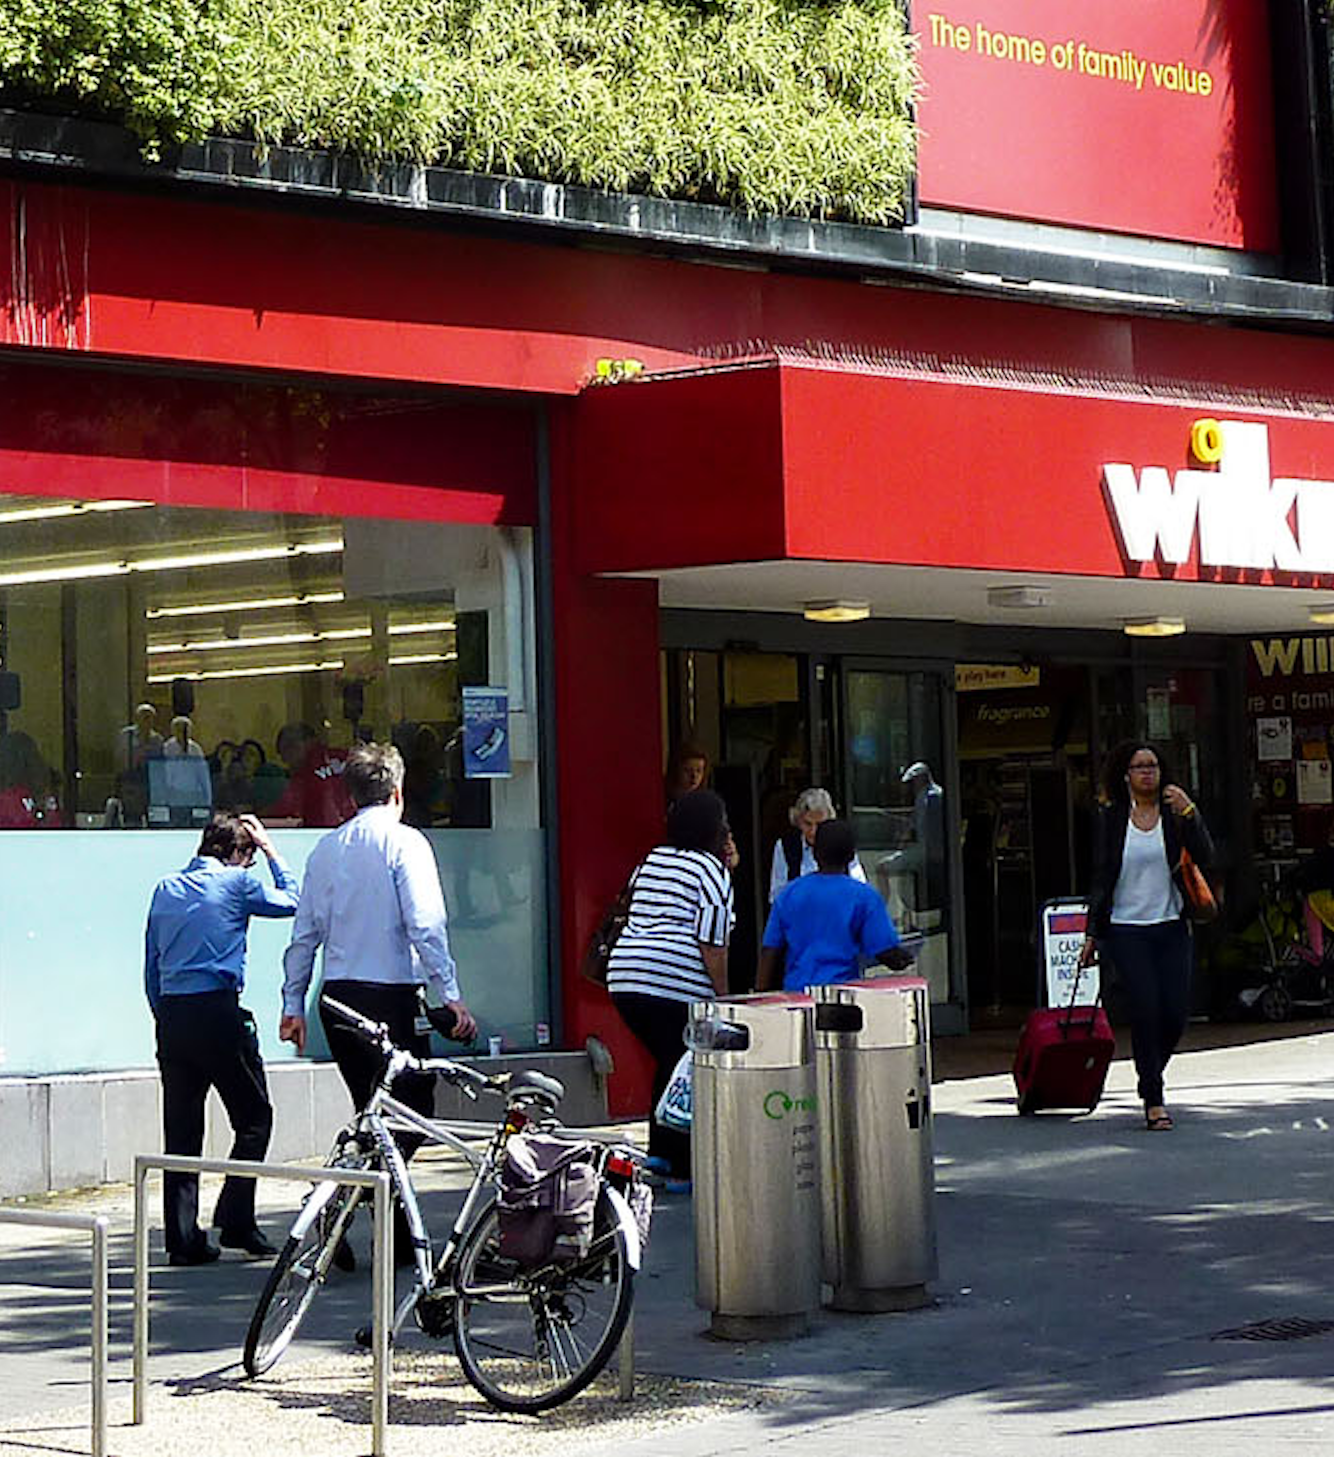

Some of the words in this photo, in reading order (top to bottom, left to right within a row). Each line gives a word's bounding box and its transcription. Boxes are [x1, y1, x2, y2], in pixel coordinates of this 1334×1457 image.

[928, 15, 970, 50] The
[977, 23, 1045, 65] home
[1051, 41, 1075, 71] of
[1077, 44, 1146, 90] family
[1151, 62, 1212, 95] value
